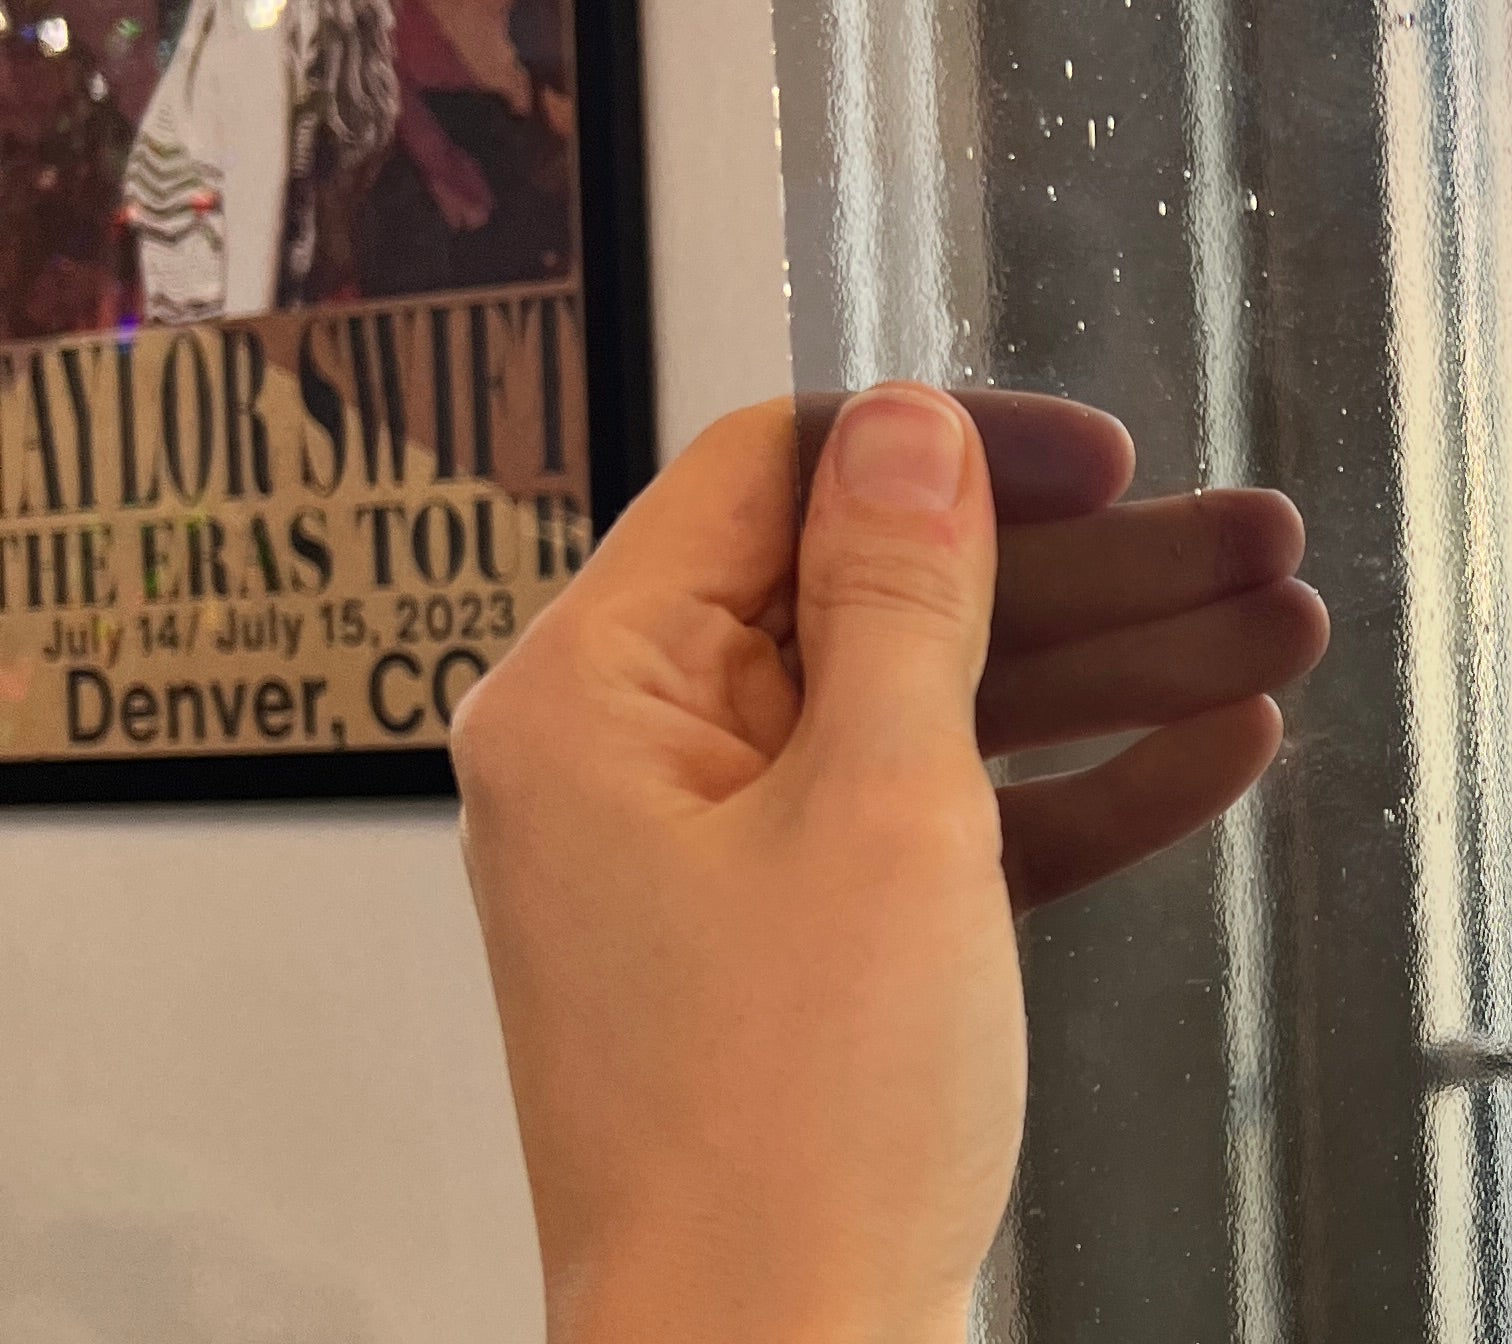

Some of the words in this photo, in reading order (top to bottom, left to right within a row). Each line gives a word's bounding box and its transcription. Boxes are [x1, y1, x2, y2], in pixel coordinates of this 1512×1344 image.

[0, 327, 274, 518] AYLOR
[296, 293, 584, 498] SWIFT
[139, 508, 333, 601] ERAS
[354, 490, 592, 591] TOUR
[42, 618, 124, 667] July
[215, 601, 302, 659] July
[318, 598, 381, 649] 15,
[399, 590, 516, 644] 2023
[66, 665, 348, 752] Denver,
[368, 646, 492, 735] CO
